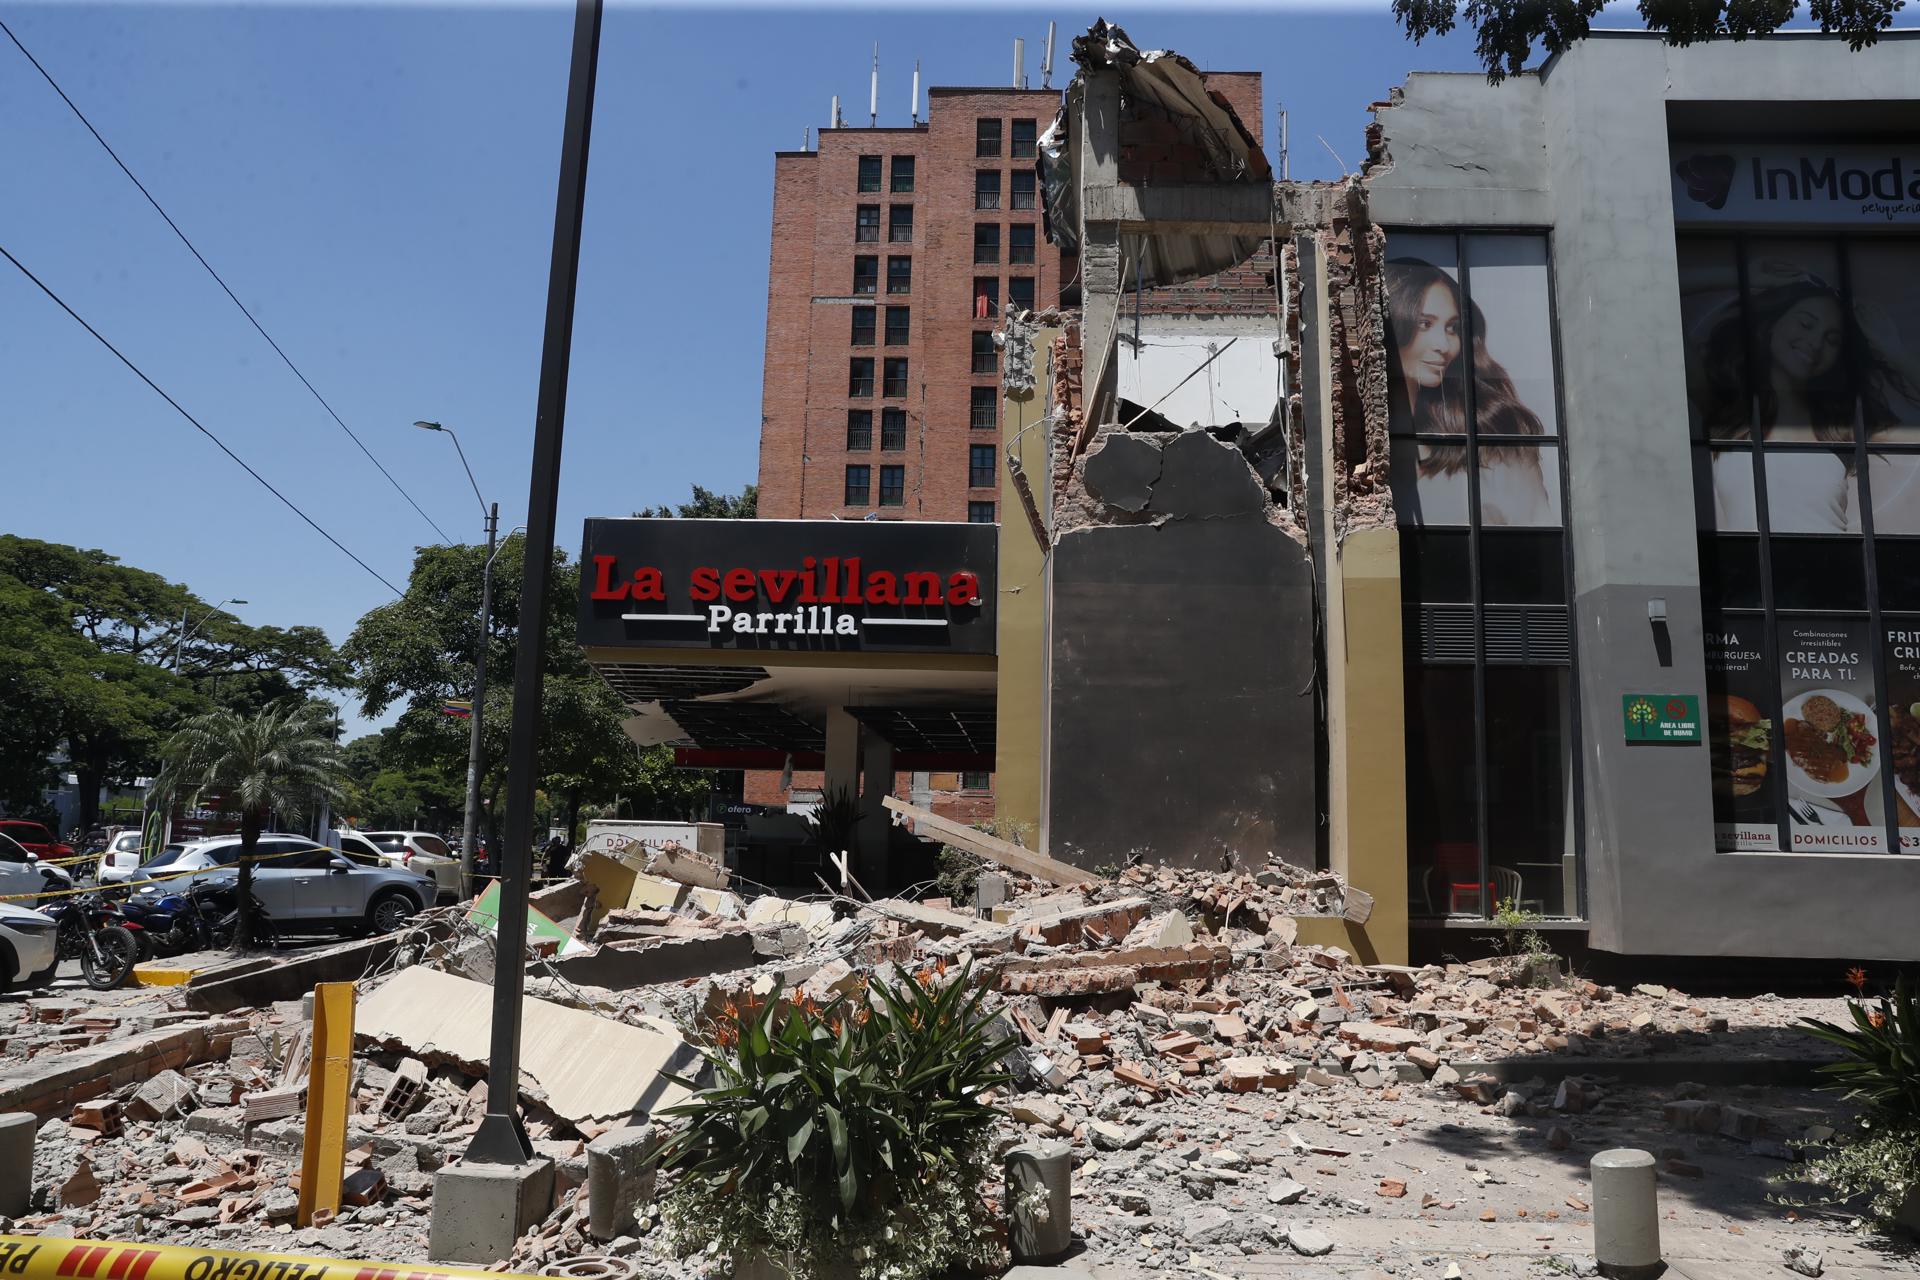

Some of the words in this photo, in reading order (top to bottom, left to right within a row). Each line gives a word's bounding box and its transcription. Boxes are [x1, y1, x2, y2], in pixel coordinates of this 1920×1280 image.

[590, 555, 665, 601] La
[688, 555, 982, 607] sevillana
[707, 604, 859, 636] Parrilla
[1793, 629, 1848, 639] Combinaciones
[1800, 639, 1842, 648] irresistibles
[1785, 651, 1859, 665] CREADAS
[1791, 667, 1833, 680] PARA
[1837, 668, 1857, 681] TI.
[1793, 834, 1878, 847] DOMICILIOS
